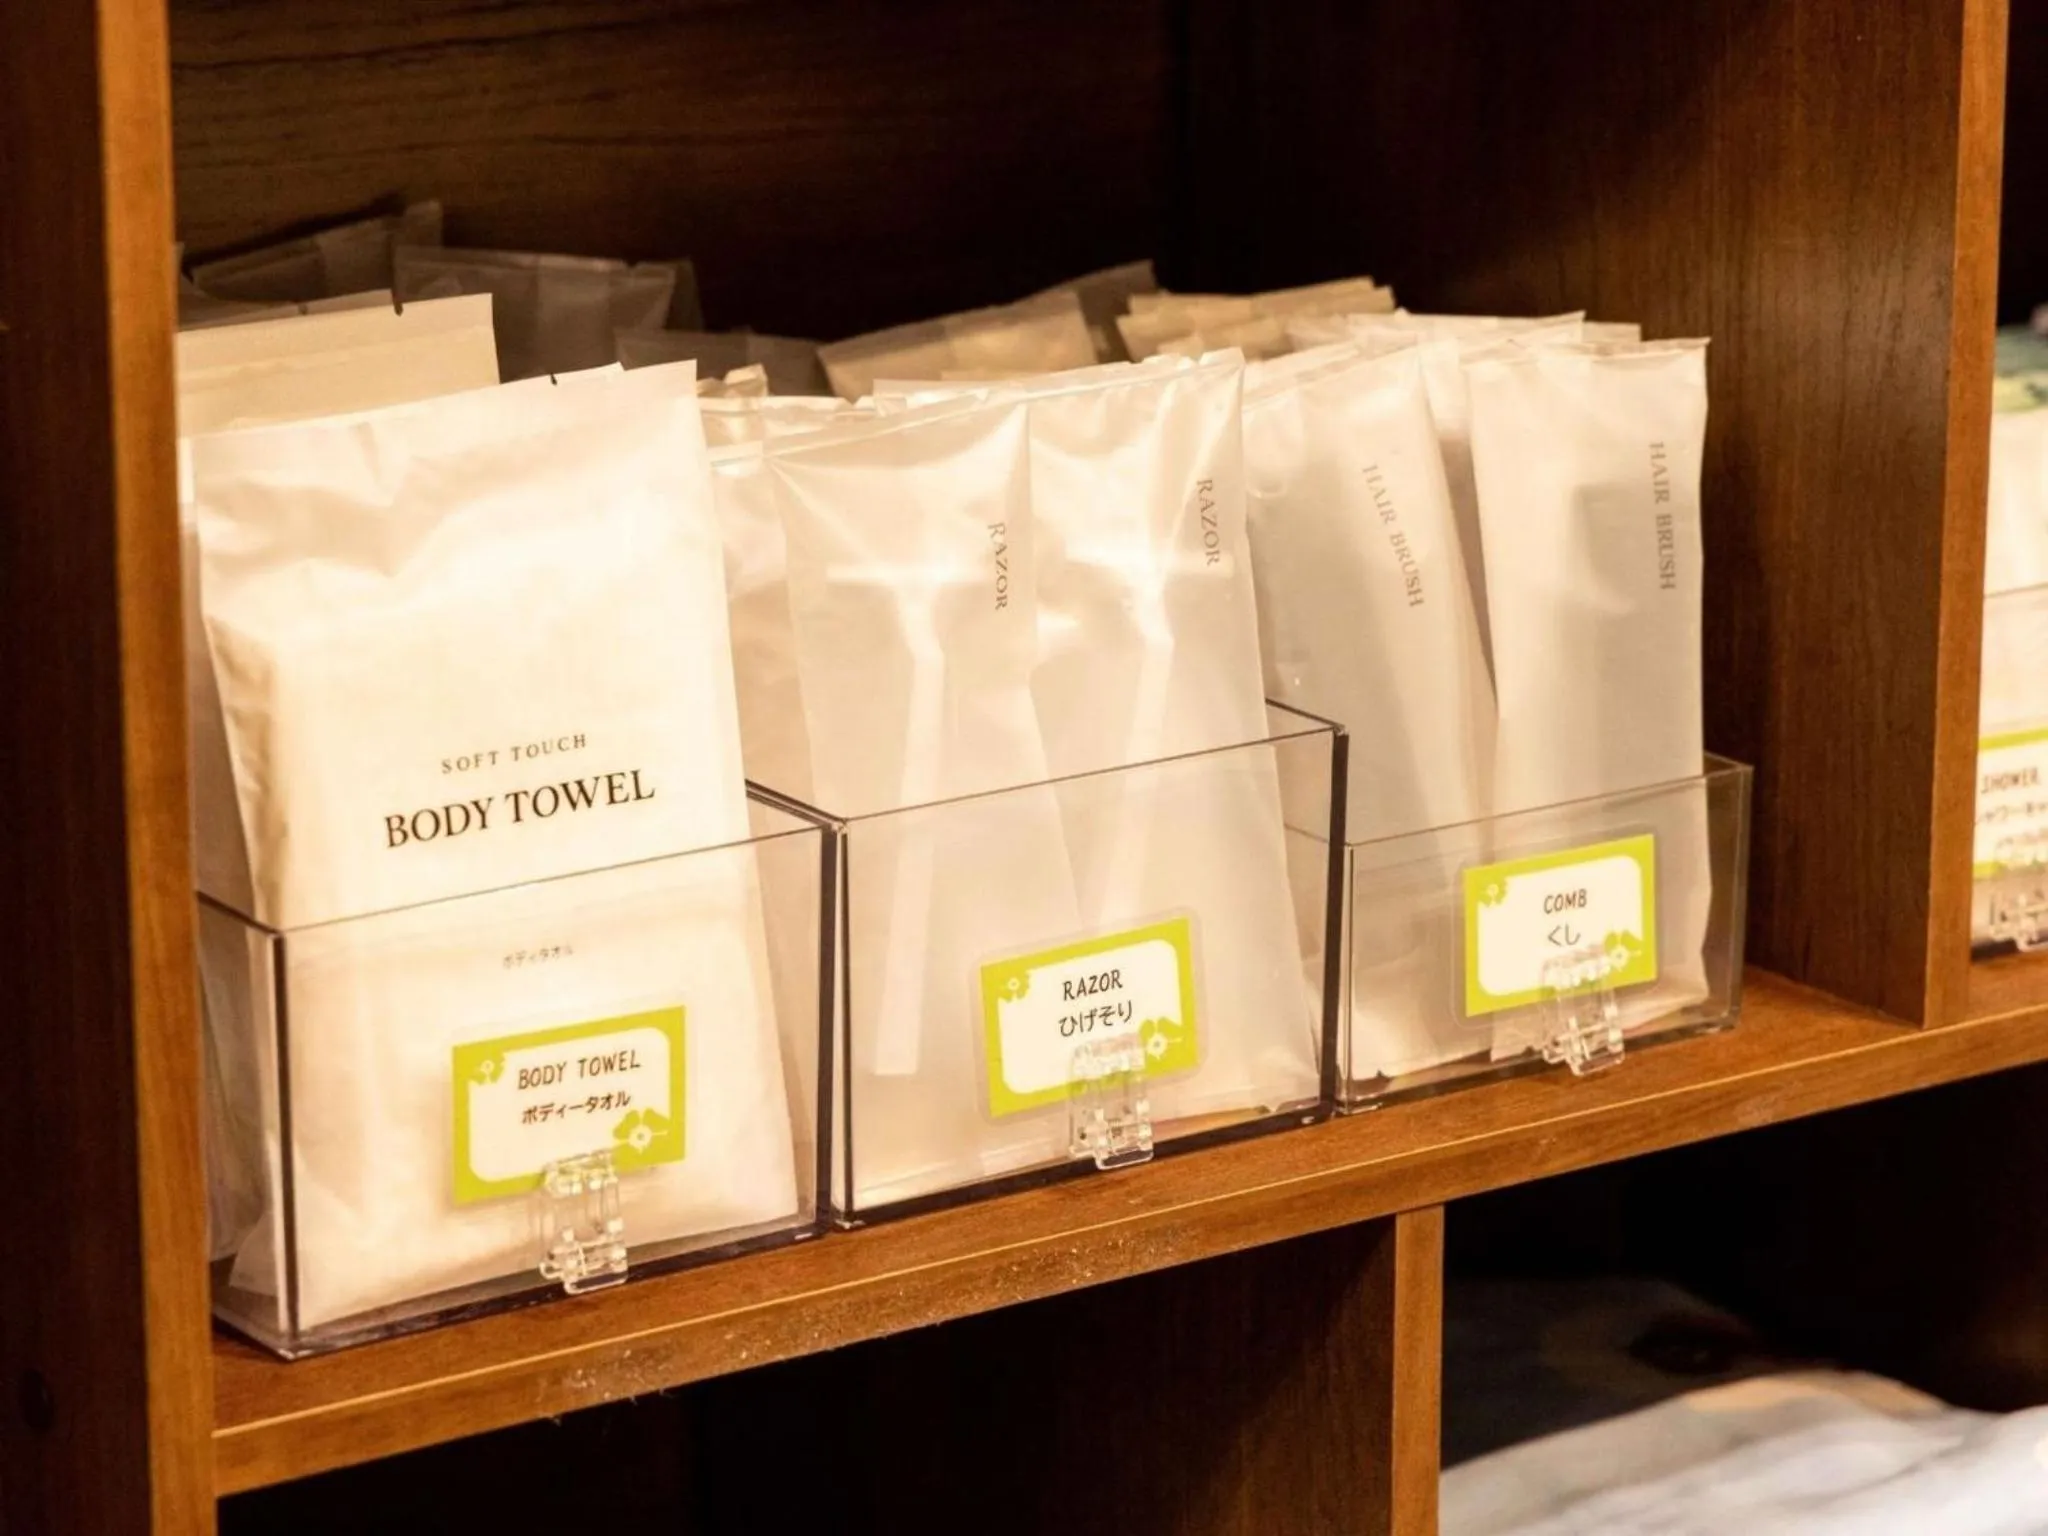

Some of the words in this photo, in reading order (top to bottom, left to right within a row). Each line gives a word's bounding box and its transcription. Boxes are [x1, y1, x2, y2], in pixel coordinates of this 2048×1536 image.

[1648, 441, 1671, 504] HAIR
[1197, 479, 1220, 566] RAZOR
[1362, 464, 1397, 526] HAIR
[1389, 531, 1425, 608] BRUSH
[988, 523, 1008, 611] RAZOR
[1655, 514, 1677, 590] BRUSH
[440, 750, 499, 775] SOFT
[510, 733, 587, 762] TOUCH
[384, 797, 494, 848] BODY
[504, 769, 655, 823] TOWEL
[1543, 888, 1588, 915] COMB
[1547, 923, 1581, 947] くし
[1062, 968, 1124, 1002] RAZOR
[1057, 999, 1133, 1038] ひげそり
[517, 1060, 568, 1091] BODY
[577, 1049, 642, 1080] TOWEL
[521, 1090, 632, 1125] ボディータオル
